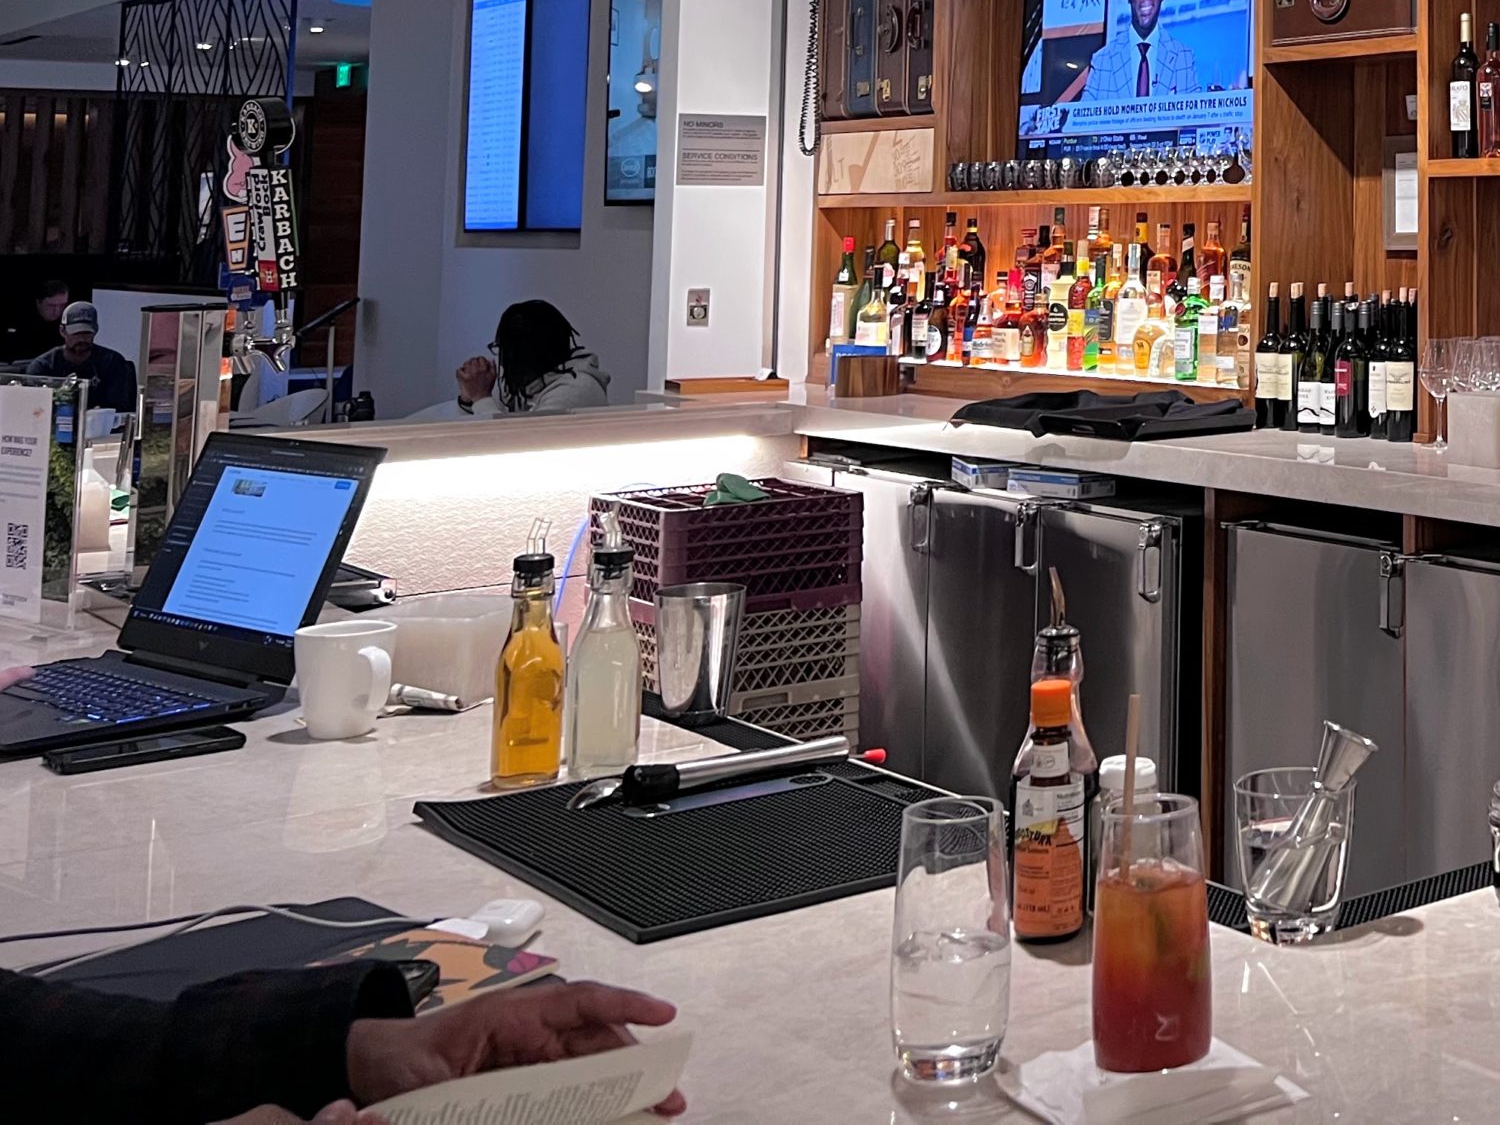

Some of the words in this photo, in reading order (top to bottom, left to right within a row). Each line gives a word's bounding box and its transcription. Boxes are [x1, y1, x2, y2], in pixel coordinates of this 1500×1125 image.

[1072, 105, 1102, 118] GRIZZLIES
[1103, 105, 1120, 116] HOLD
[1121, 103, 1148, 115] MOMENT
[1149, 103, 1157, 113] OF
[1158, 101, 1184, 112] SILENCE
[1185, 100, 1199, 111] FOR
[1200, 98, 1216, 110] TYRE
[1217, 96, 1247, 108] NICHOLS
[682, 152, 713, 160] SERVICE
[714, 153, 758, 161] CONDITIONS
[253, 173, 267, 252] Crawford
[260, 172, 271, 217] Bock
[271, 170, 298, 289] KARBACH
